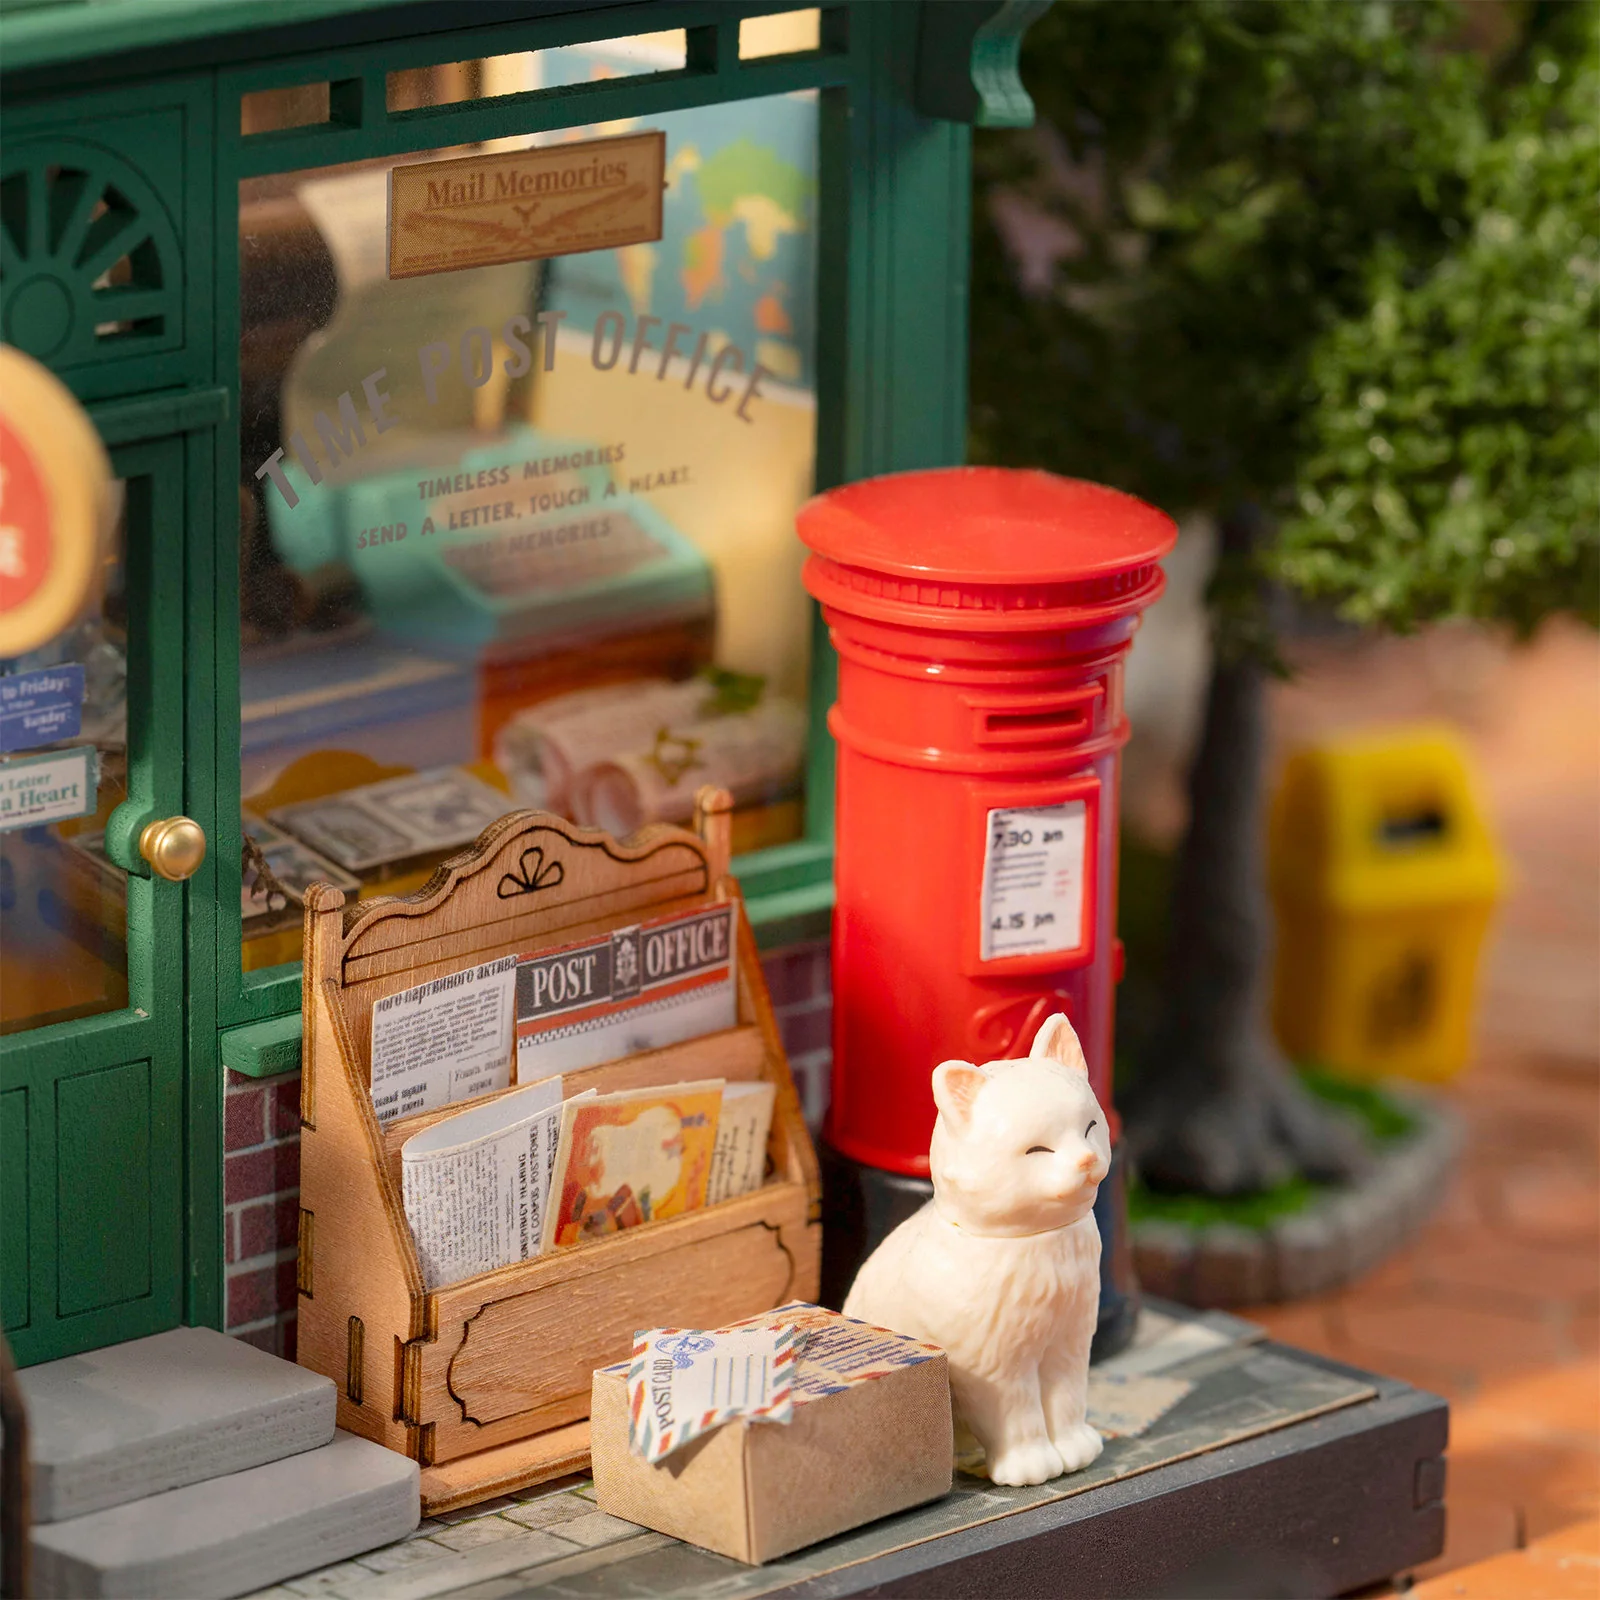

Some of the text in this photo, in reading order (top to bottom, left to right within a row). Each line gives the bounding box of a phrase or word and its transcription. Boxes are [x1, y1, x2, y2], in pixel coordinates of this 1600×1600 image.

[427, 157, 628, 208] Mail Memories
[254, 309, 776, 510] TIME POST OFFICE
[418, 442, 626, 501] TIMELESS MEMORIES
[356, 522, 408, 550] SEND
[421, 516, 436, 537] A
[448, 501, 522, 532] LETTER,
[529, 485, 590, 516] TOUCH
[603, 480, 617, 498] A
[20, 782, 79, 808] Heart
[531, 915, 728, 1009] POST OFFICE
[651, 1358, 675, 1432] POST CARD
